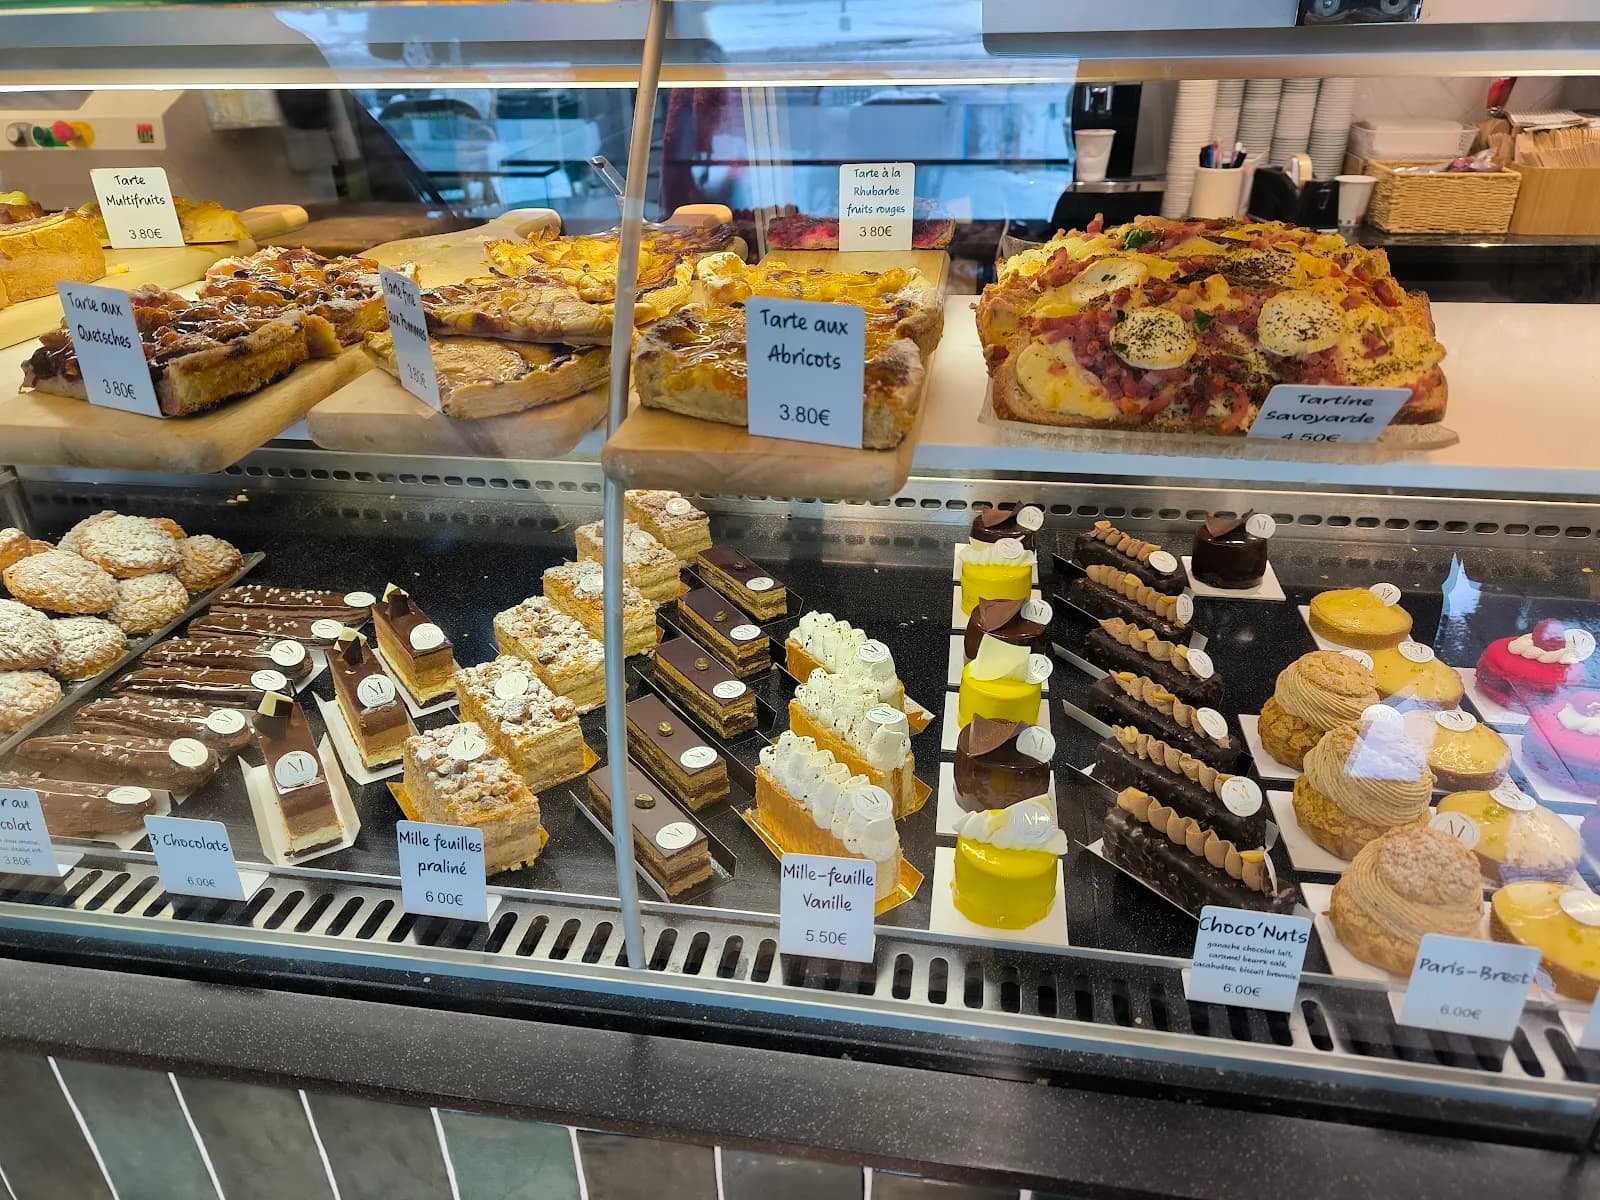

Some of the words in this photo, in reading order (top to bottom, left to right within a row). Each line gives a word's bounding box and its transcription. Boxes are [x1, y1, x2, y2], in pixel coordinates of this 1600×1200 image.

[113, 175, 146, 186] Tarte
[853, 168, 879, 178] Tarte
[882, 167, 889, 178] à
[892, 166, 901, 178] la
[853, 185, 900, 196] Rhubarbe
[105, 193, 166, 209] Multifruits
[846, 203, 873, 217] fruits
[876, 205, 906, 217] rouges
[859, 225, 893, 237] 3.80€
[67, 292, 99, 313] Tarte
[101, 301, 123, 317] aux
[760, 308, 809, 331] Tarte
[814, 319, 849, 336] aux
[77, 323, 132, 349] Quetsches
[767, 343, 842, 370] Abricots
[102, 378, 137, 400] 3.80€
[1298, 394, 1375, 407] Tartine
[779, 403, 831, 426] 3.80€
[1265, 410, 1375, 425] Savoyarde
[11, 799, 30, 809] au
[0, 817, 33, 832] colat
[150, 833, 159, 846] 3
[163, 833, 229, 852] Chocolats
[399, 830, 430, 847] Mille
[434, 833, 482, 853] feuilles
[418, 858, 467, 877] praliné
[783, 863, 874, 887] Mille-feuille
[187, 875, 217, 888] 6.00€
[803, 893, 852, 912] Vanille
[805, 929, 848, 946] 5.50€
[1199, 916, 1308, 944] Choco'Nuts
[1207, 942, 1240, 950] ganache
[1242, 944, 1276, 955] chocolat
[1208, 952, 1241, 961] caramel
[1243, 955, 1268, 965] beurre
[1419, 958, 1530, 985] Paris-Brest
[1223, 983, 1262, 997] 6.00€
[1440, 1003, 1482, 1020] 6.00€
